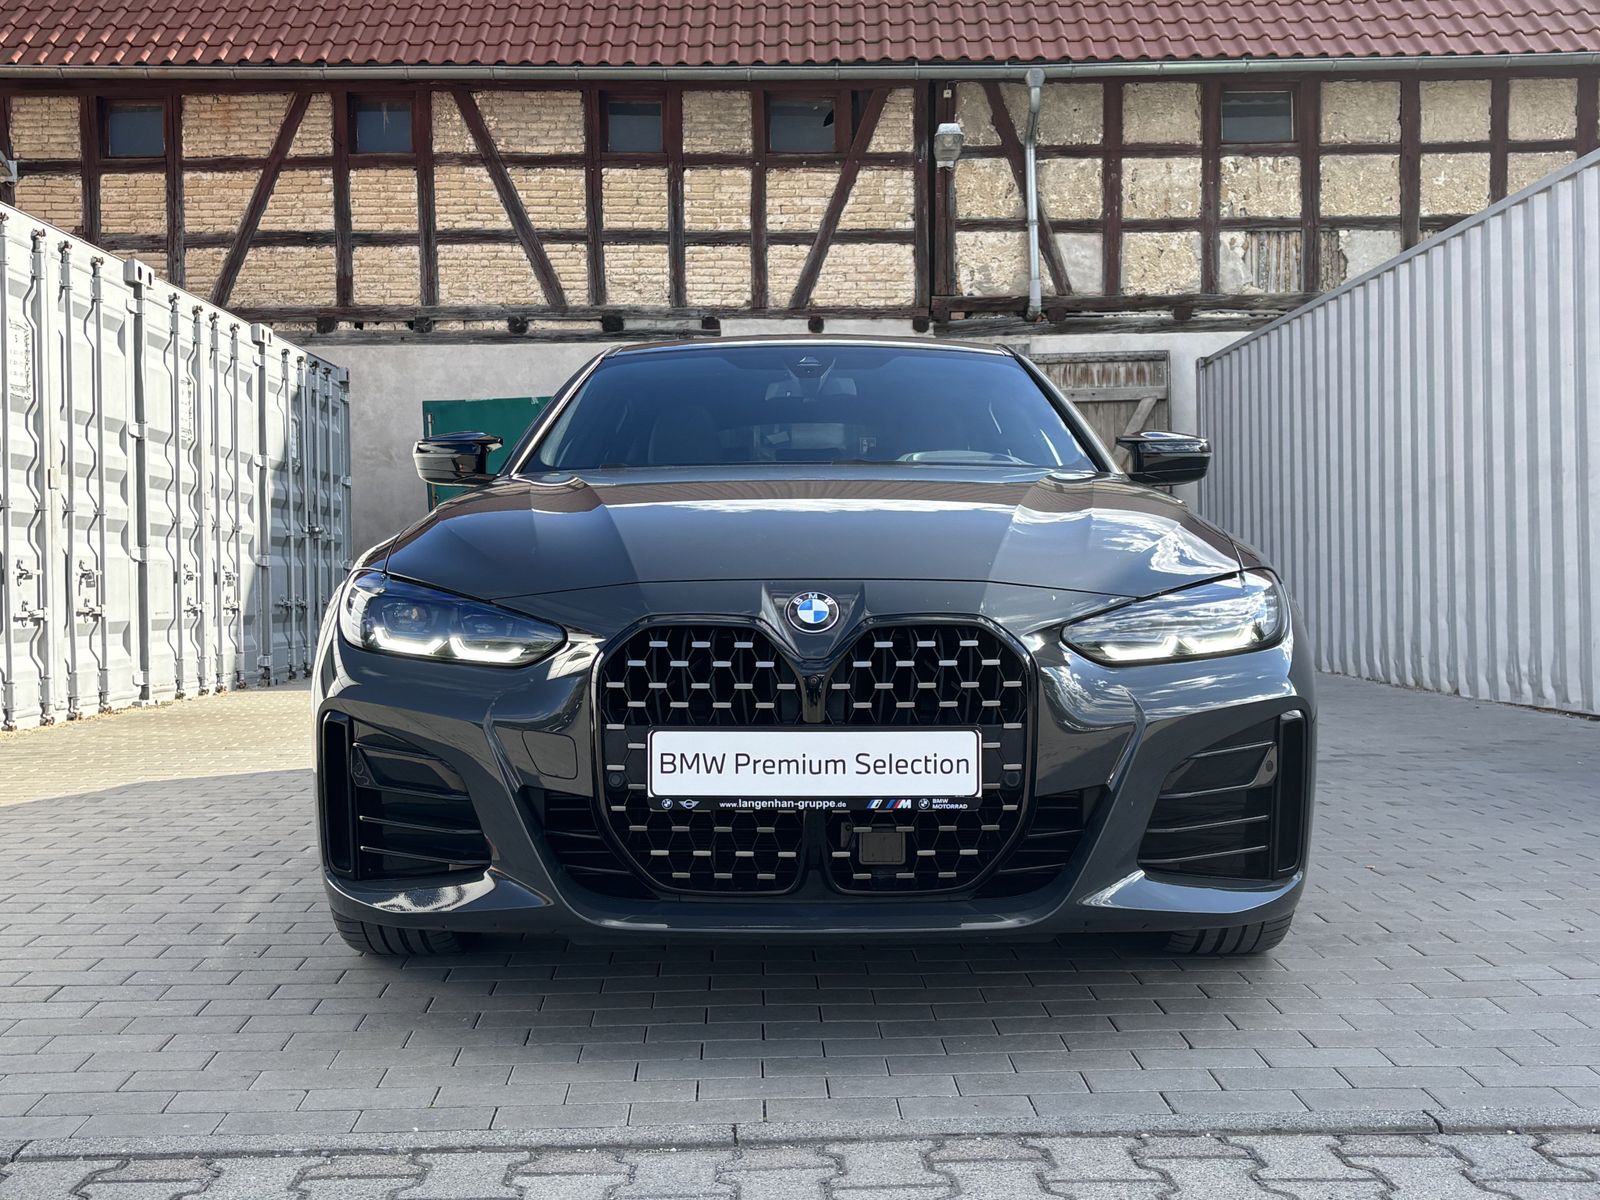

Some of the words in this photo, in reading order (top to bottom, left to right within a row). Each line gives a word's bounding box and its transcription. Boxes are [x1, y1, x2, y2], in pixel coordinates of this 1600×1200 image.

[793, 593, 835, 605] BMW
[660, 753, 726, 774] BMW
[735, 753, 846, 774] Premium
[855, 752, 970, 774] Selection
[719, 799, 847, 809] www.langenhan-gruppe.de
